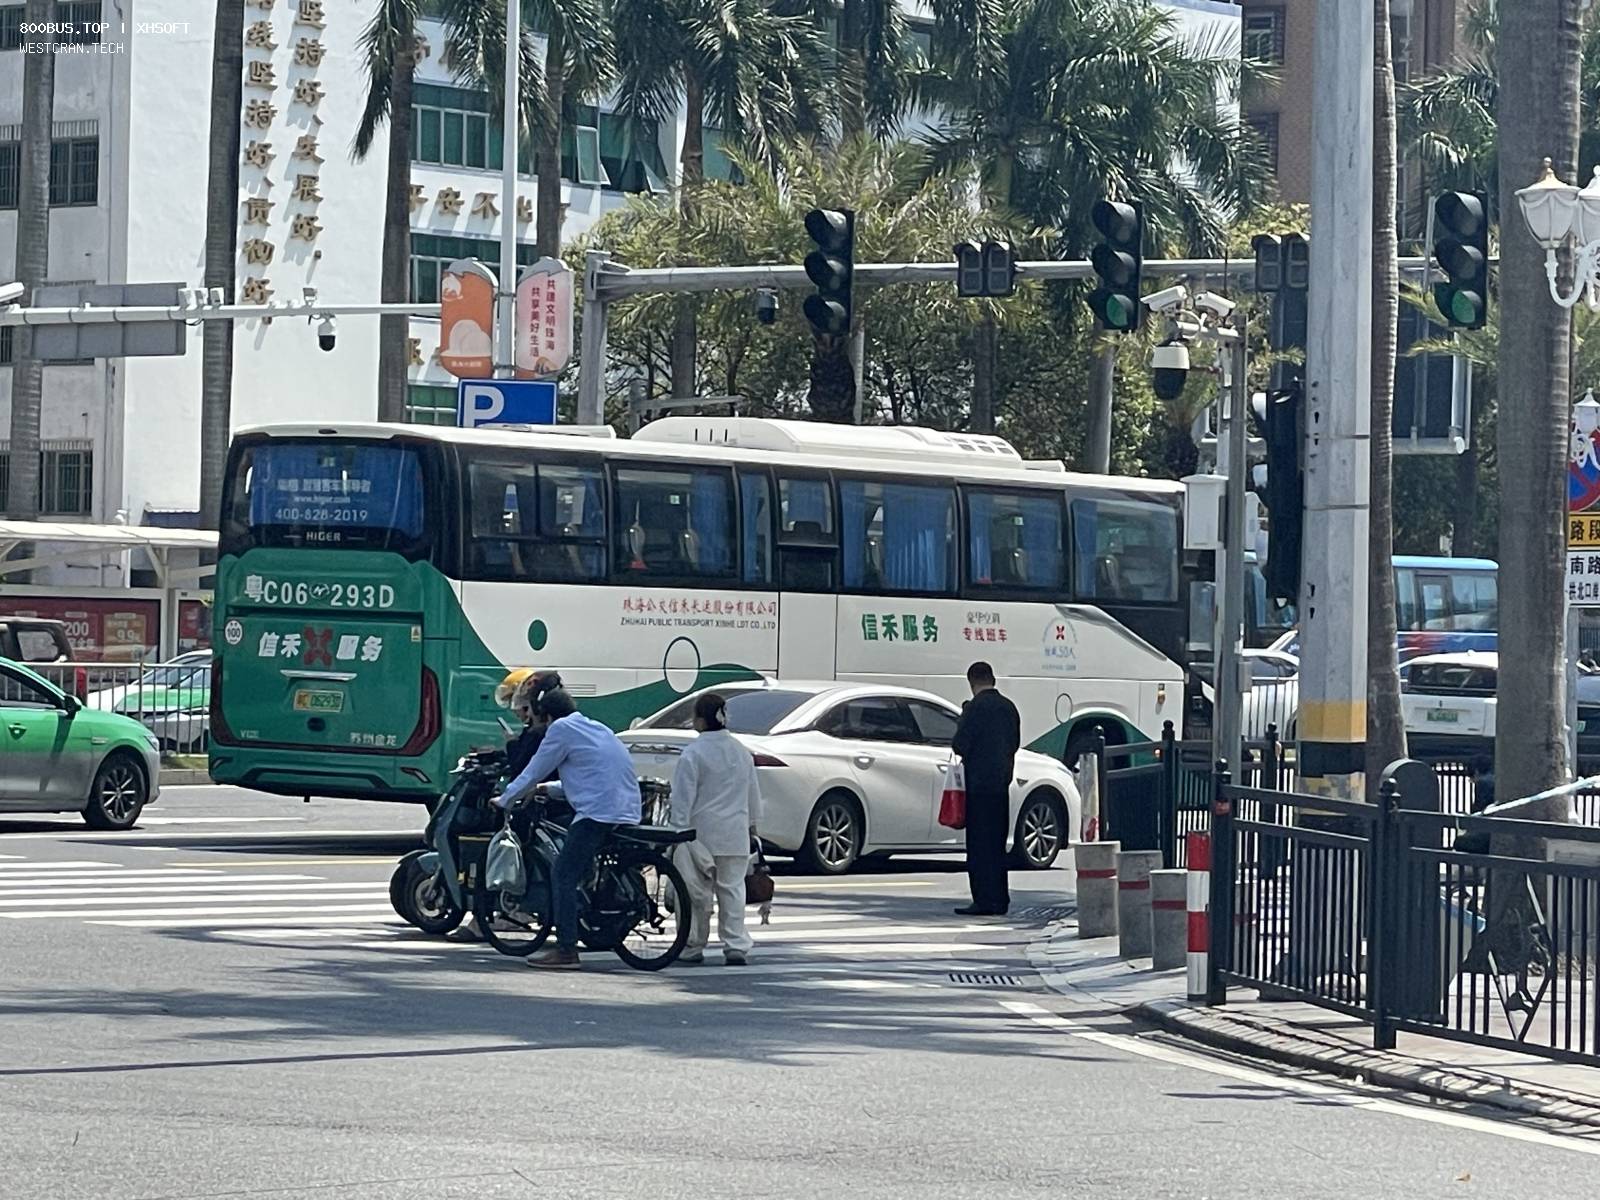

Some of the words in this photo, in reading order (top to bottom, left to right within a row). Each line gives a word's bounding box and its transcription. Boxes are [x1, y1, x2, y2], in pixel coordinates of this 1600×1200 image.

[529, 287, 541, 358] 共享美好生活
[545, 279, 557, 352] 共建文明珠海
[464, 384, 505, 427] P
[306, 531, 342, 542] HIGER
[1570, 556, 1600, 575] 南路
[330, 583, 395, 609] 293D
[648, 617, 673, 627] PUBLIC
[674, 618, 714, 628] TRANSPORT
[861, 613, 939, 643] 信禾服务
[962, 626, 1008, 643] 专线班车
